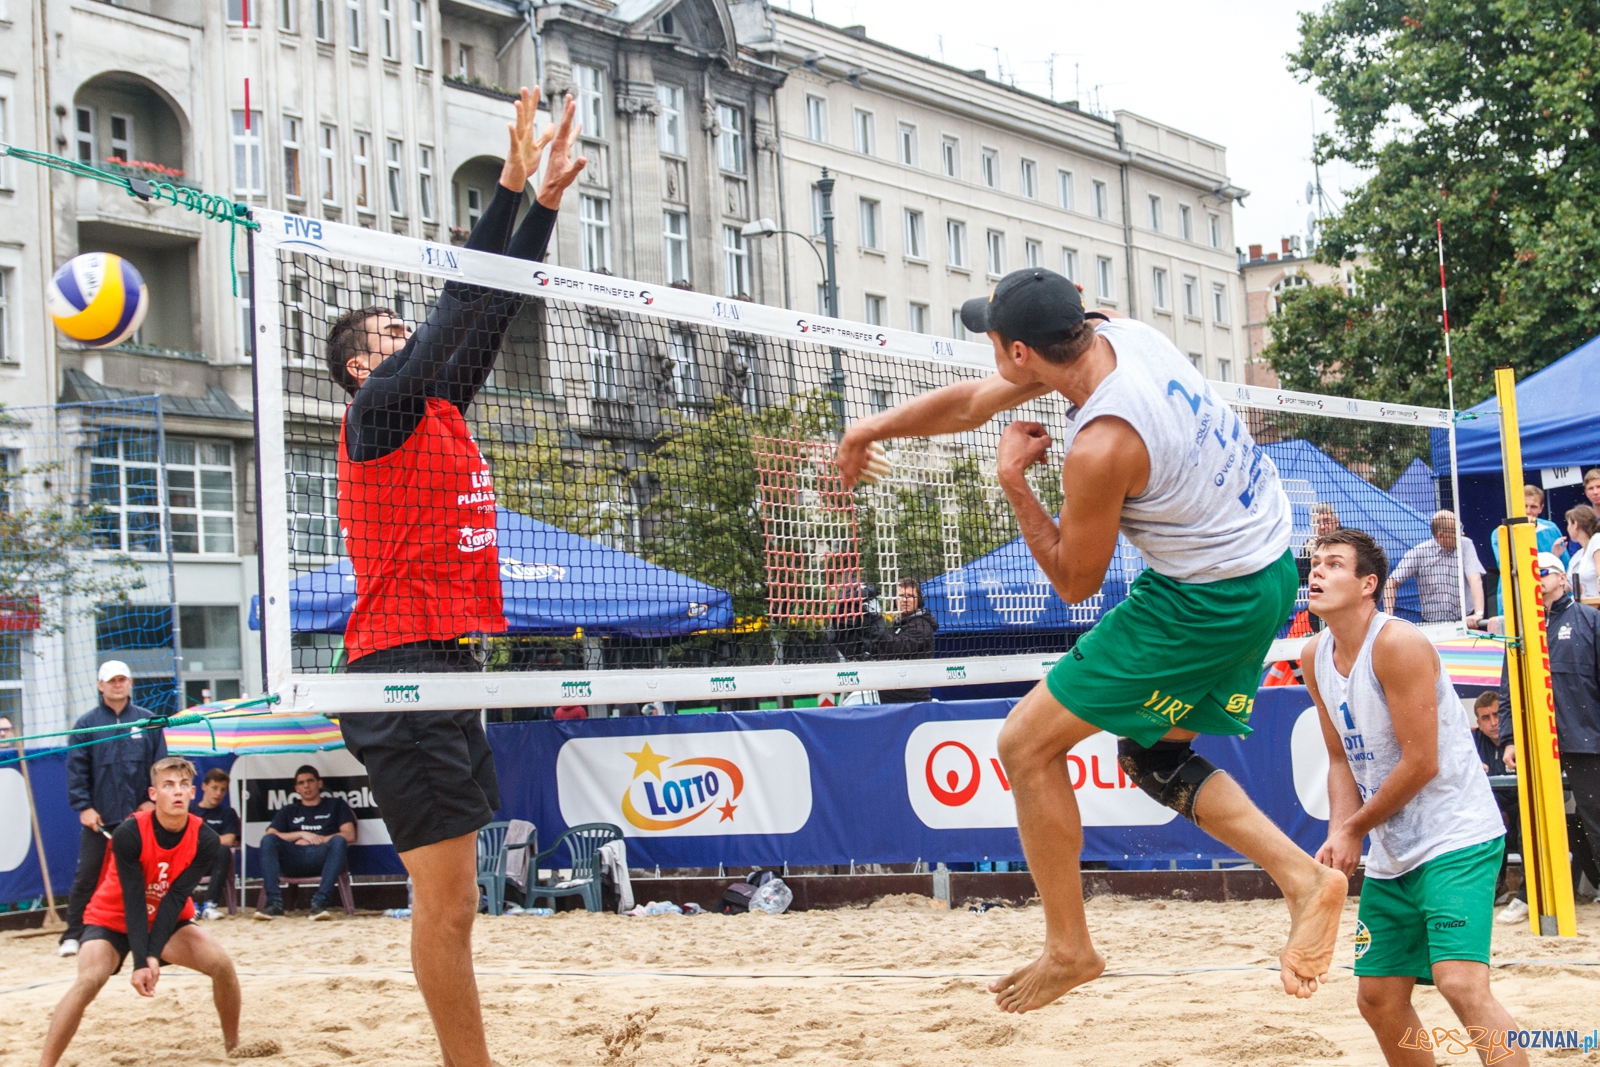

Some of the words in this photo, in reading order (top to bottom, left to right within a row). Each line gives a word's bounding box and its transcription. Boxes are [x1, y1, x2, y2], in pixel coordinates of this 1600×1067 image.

[283, 215, 323, 240] FIVB
[553, 276, 585, 291] SPORT
[587, 283, 636, 300] TRANSFER
[811, 324, 836, 335] SPORT
[836, 328, 874, 342] TRANSFER
[1167, 379, 1202, 416] 2
[1552, 466, 1570, 480] VIP
[836, 671, 860, 686] HUCK
[945, 665, 967, 680] HUCK
[561, 681, 592, 698] HUCK
[710, 676, 737, 692] HUCK
[383, 685, 420, 703] HUCK
[1339, 701, 1356, 730] 1
[643, 770, 720, 816] LOTTO
[157, 862, 170, 881] 2
